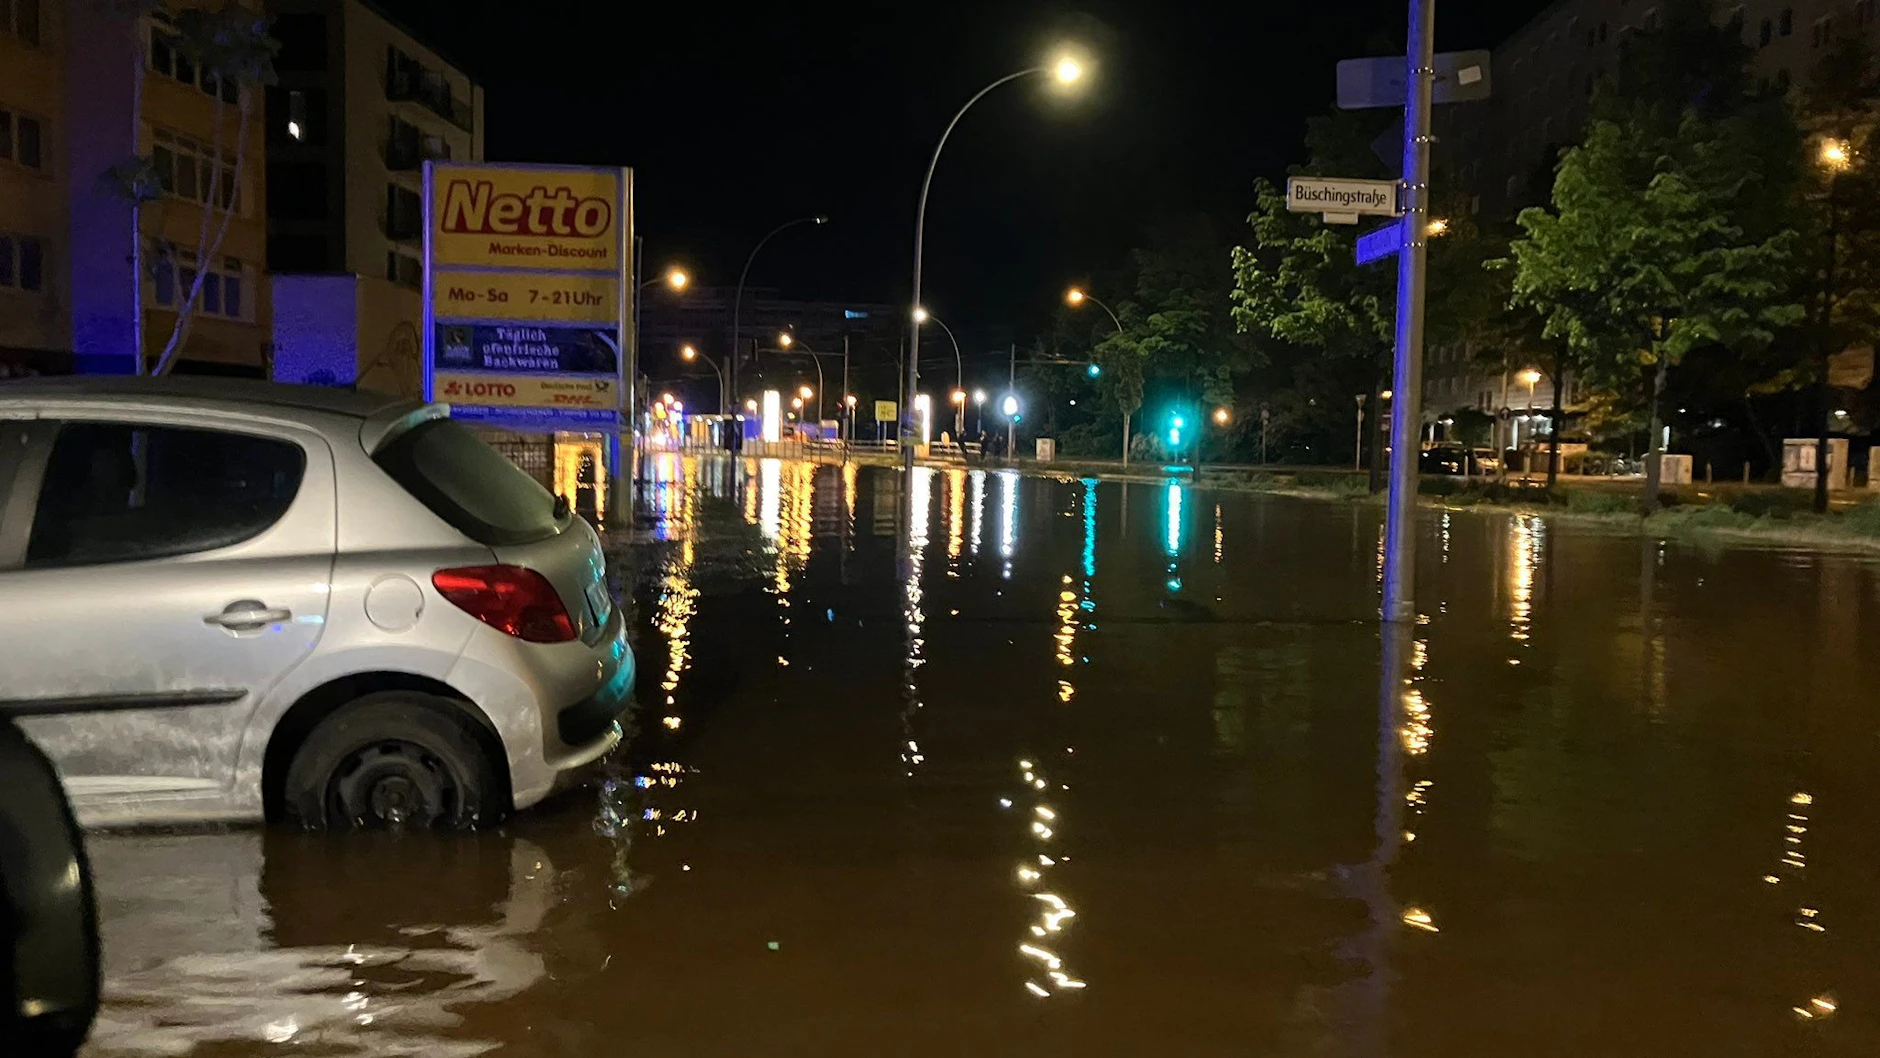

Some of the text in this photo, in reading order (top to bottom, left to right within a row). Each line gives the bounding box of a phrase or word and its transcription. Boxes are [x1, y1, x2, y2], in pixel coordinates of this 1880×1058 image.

[1295, 185, 1387, 207] Büschingstraße
[441, 179, 611, 238] Netto
[489, 242, 607, 258] Marken-Discount
[496, 327, 547, 342] Täglich
[465, 382, 516, 397] LOTTO
